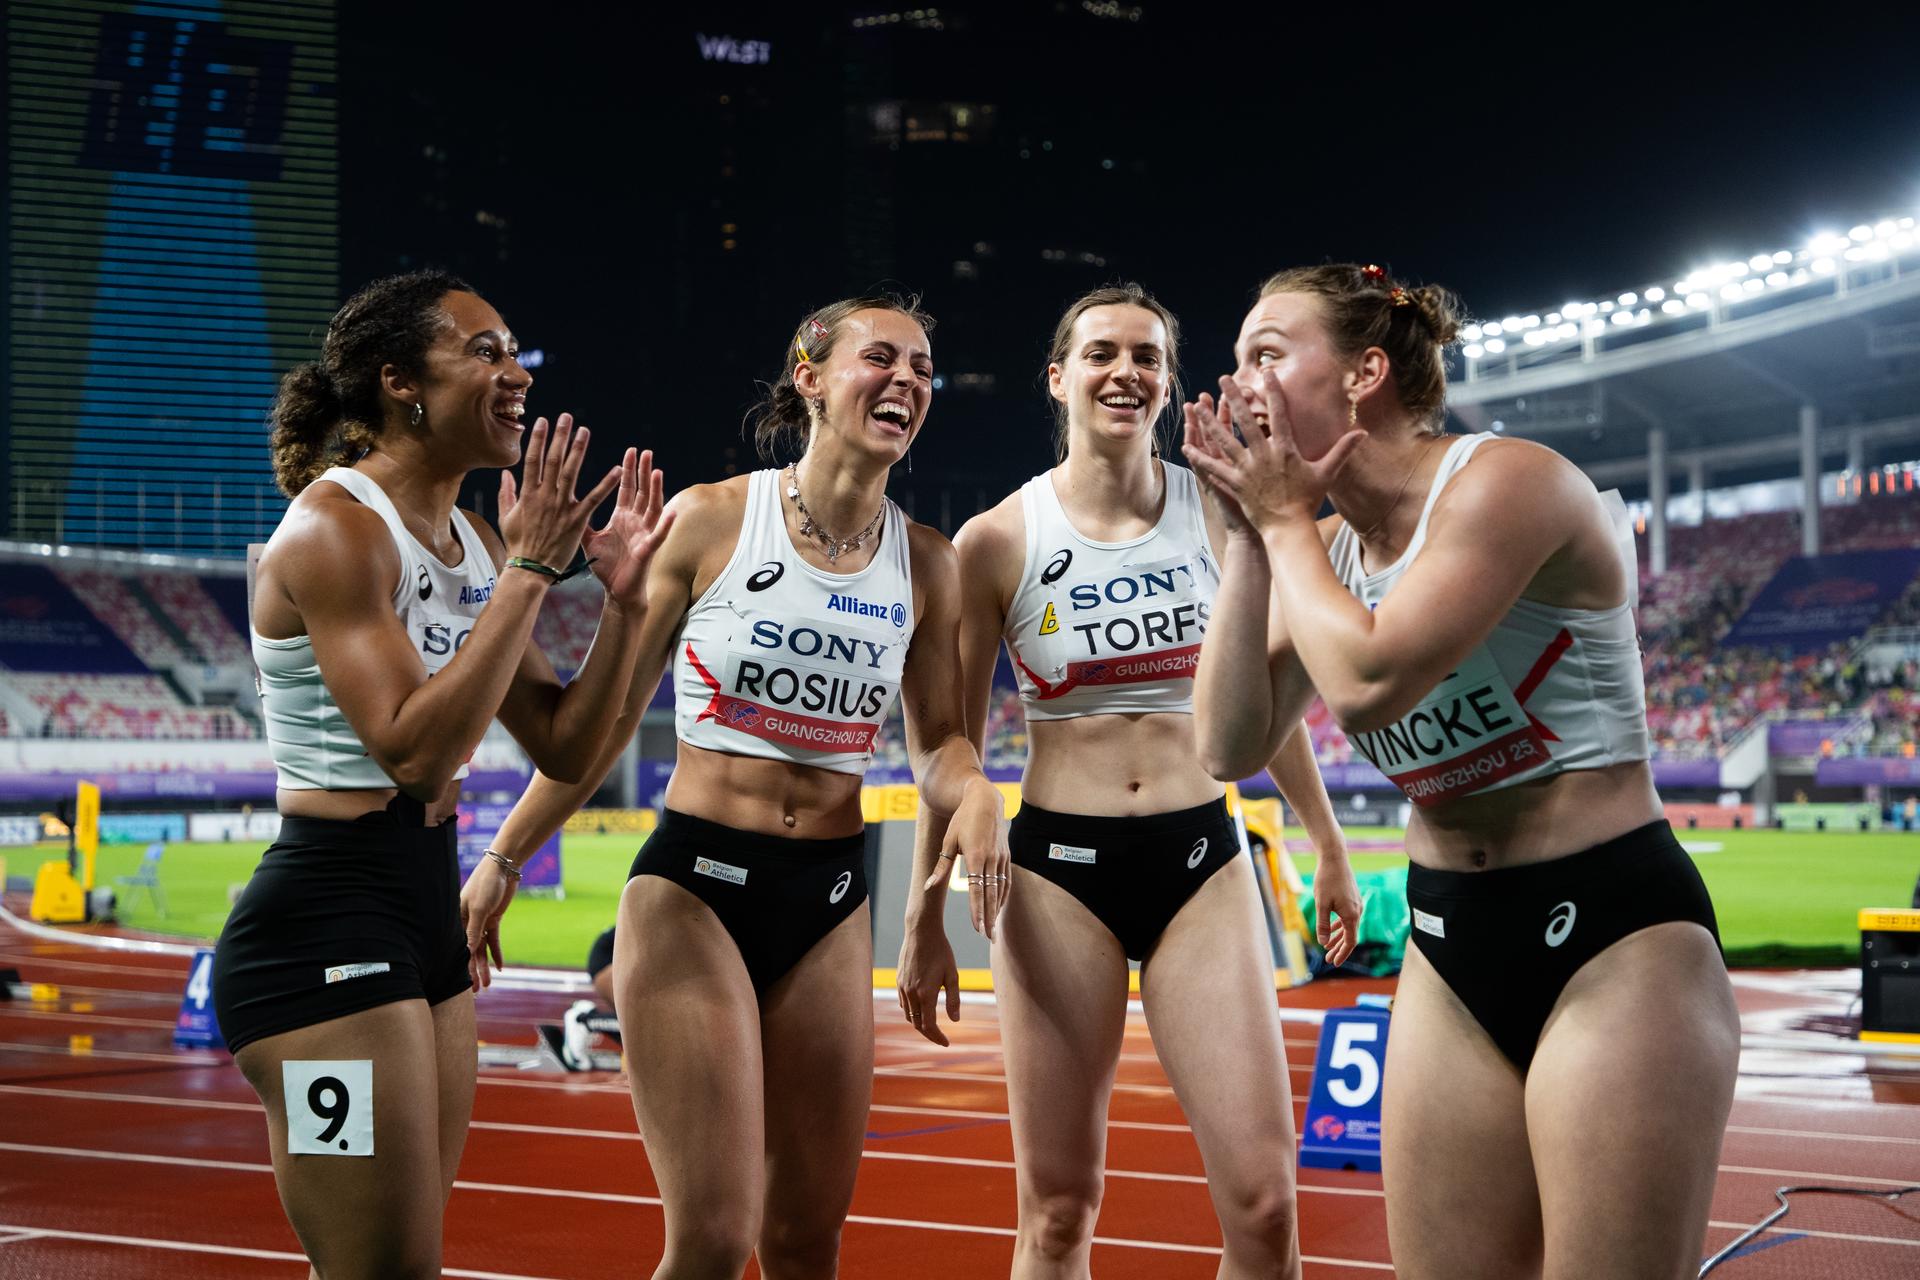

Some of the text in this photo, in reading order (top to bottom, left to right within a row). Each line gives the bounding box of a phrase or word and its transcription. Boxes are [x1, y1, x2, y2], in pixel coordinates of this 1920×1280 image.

[827, 594, 888, 619] Allianz
[751, 620, 888, 669] SONY
[735, 660, 887, 718] ROSIUS
[765, 717, 868, 744] GUANGZHOU 25
[1354, 685, 1513, 769] VINCKE
[1404, 751, 1507, 798] GUANGZHOU
[1511, 739, 1535, 760] 25
[711, 869, 744, 883] Athletics
[712, 863, 733, 873] Belgian
[1064, 853, 1094, 862] Athletics
[187, 953, 213, 1010] 4
[1327, 1022, 1380, 1107] 5
